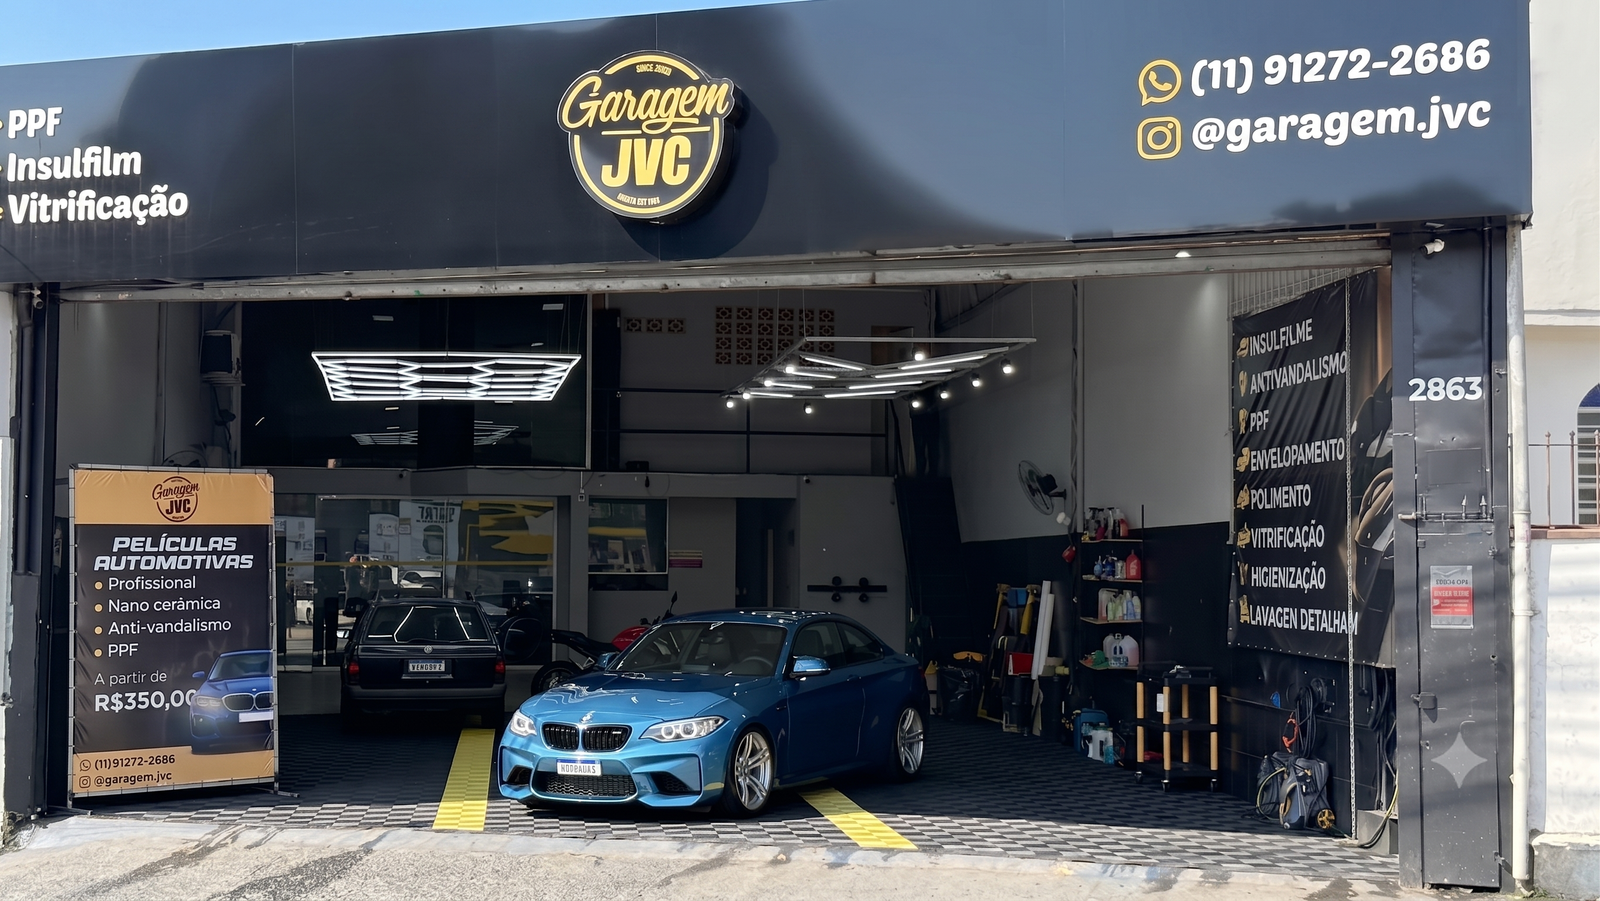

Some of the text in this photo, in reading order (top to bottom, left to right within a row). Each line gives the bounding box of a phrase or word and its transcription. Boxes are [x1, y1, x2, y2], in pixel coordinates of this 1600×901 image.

[1191, 38, 1491, 96] (11) 91272-2686
[562, 75, 730, 134] Garagem
[8, 107, 63, 138] PPF
[1191, 96, 1492, 152] @garagem.jvc
[7, 146, 142, 182] Insulfilm
[601, 135, 692, 188] JVC
[8, 184, 189, 226] Vitrificação
[1250, 318, 1313, 357] INSULFILME
[1408, 376, 1483, 402] 2863
[1250, 409, 1270, 433] PPF
[152, 483, 201, 501] Garagem
[1251, 484, 1312, 510] POLIMENTO
[165, 498, 191, 515] JVC
[112, 533, 238, 553] PELÍCULAS
[1251, 519, 1325, 553] VITRIFICAÇÃO
[93, 554, 254, 571] AUTOMOTIVAS
[108, 575, 196, 591] Profissional
[1251, 561, 1326, 594] HIGIENIZAÇÃO
[108, 599, 150, 612] Nano
[1250, 605, 1298, 630] LAVAGEN
[108, 618, 232, 635] Anti-vandalismo
[108, 643, 139, 657] PPF
[94, 670, 168, 687] A partir de
[94, 754, 176, 770] (11)91272-2686
[93, 771, 173, 788] @garagem.jvc
